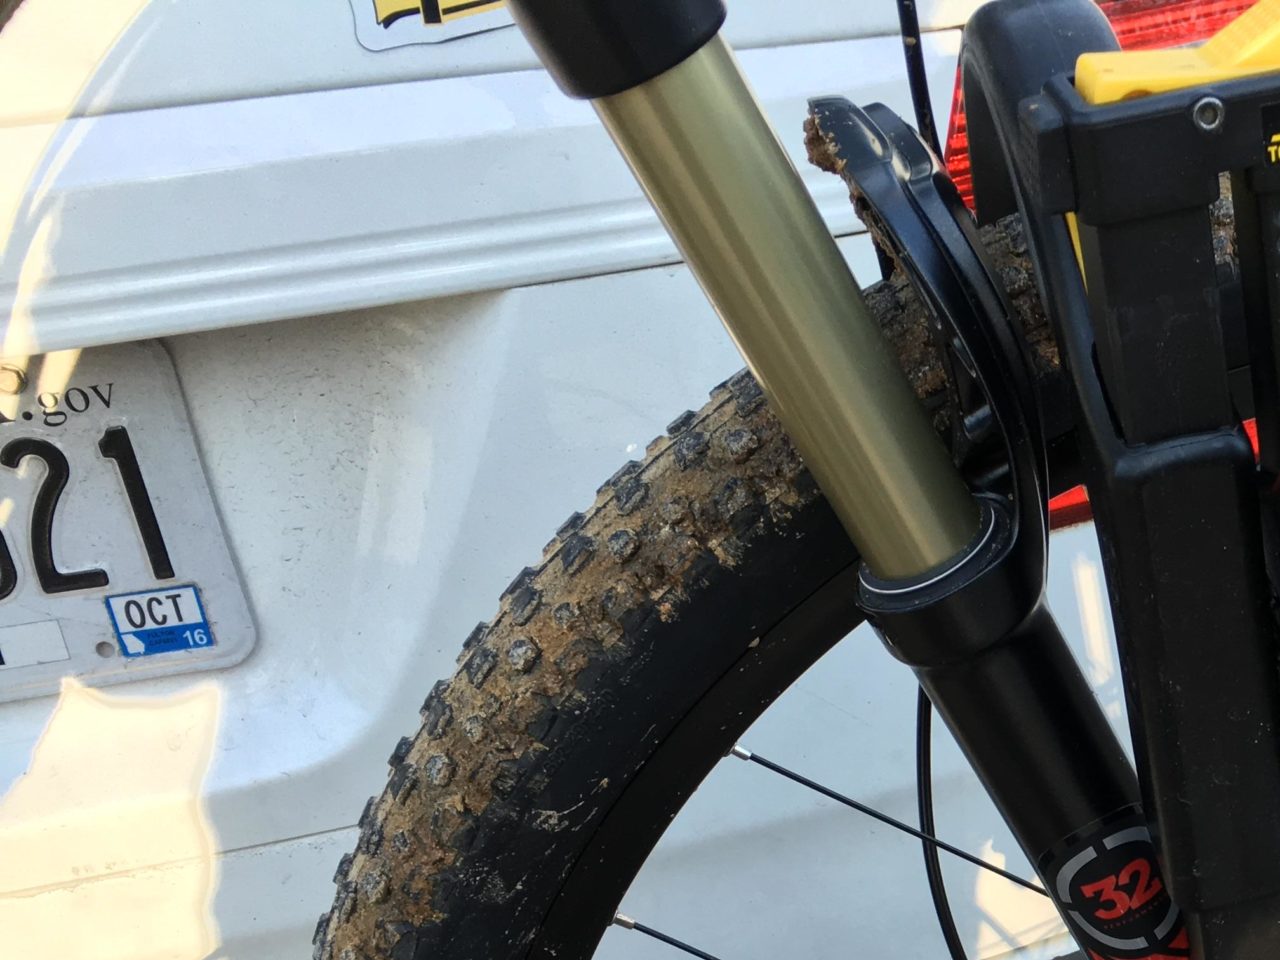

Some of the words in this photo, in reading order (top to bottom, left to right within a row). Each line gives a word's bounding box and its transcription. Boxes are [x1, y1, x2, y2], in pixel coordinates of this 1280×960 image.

[0, 383, 114, 427] .gov
[0, 425, 175, 600] 21
[124, 593, 184, 629] OCT
[182, 627, 208, 646] 16
[1080, 857, 1163, 920] 32
